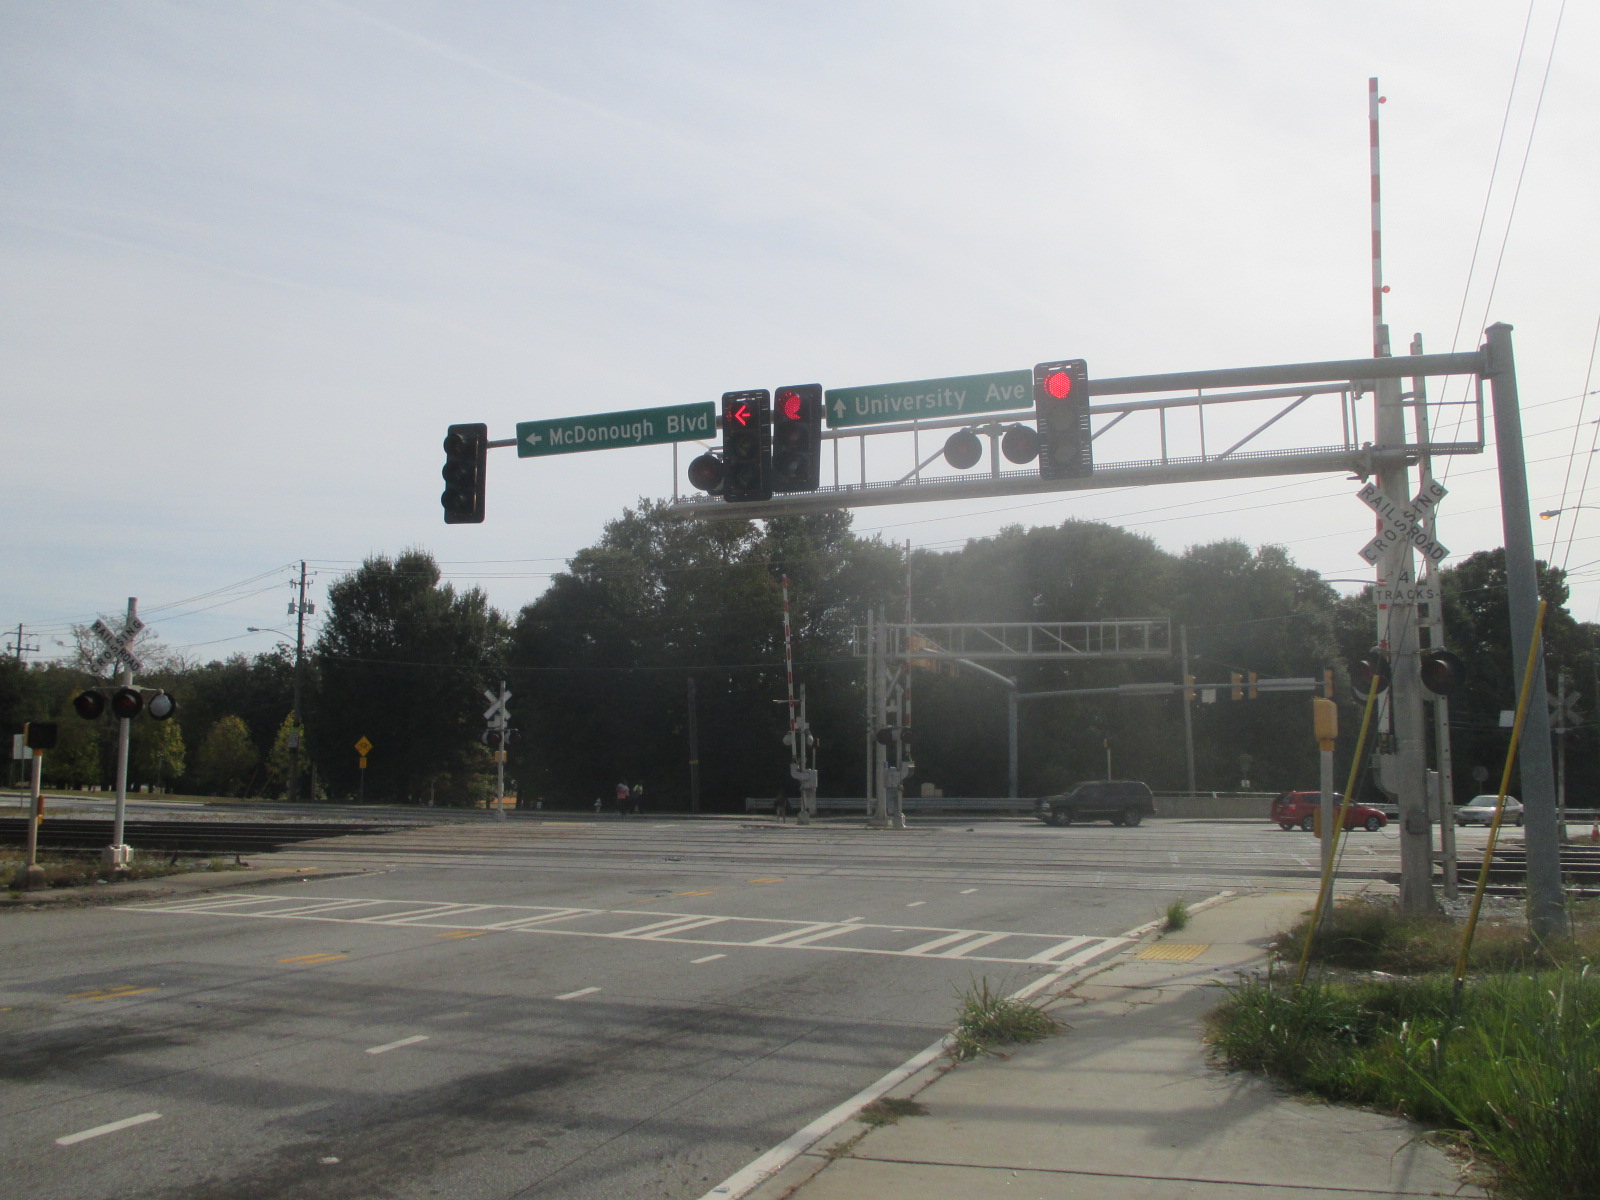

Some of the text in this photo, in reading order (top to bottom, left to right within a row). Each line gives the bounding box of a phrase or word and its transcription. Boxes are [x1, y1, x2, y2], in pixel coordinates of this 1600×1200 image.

[855, 382, 1025, 416] University Ave
[549, 412, 708, 447] McDonough Blvd
[1399, 571, 1409, 583] 4
[1376, 589, 1434, 599] TRACKS
